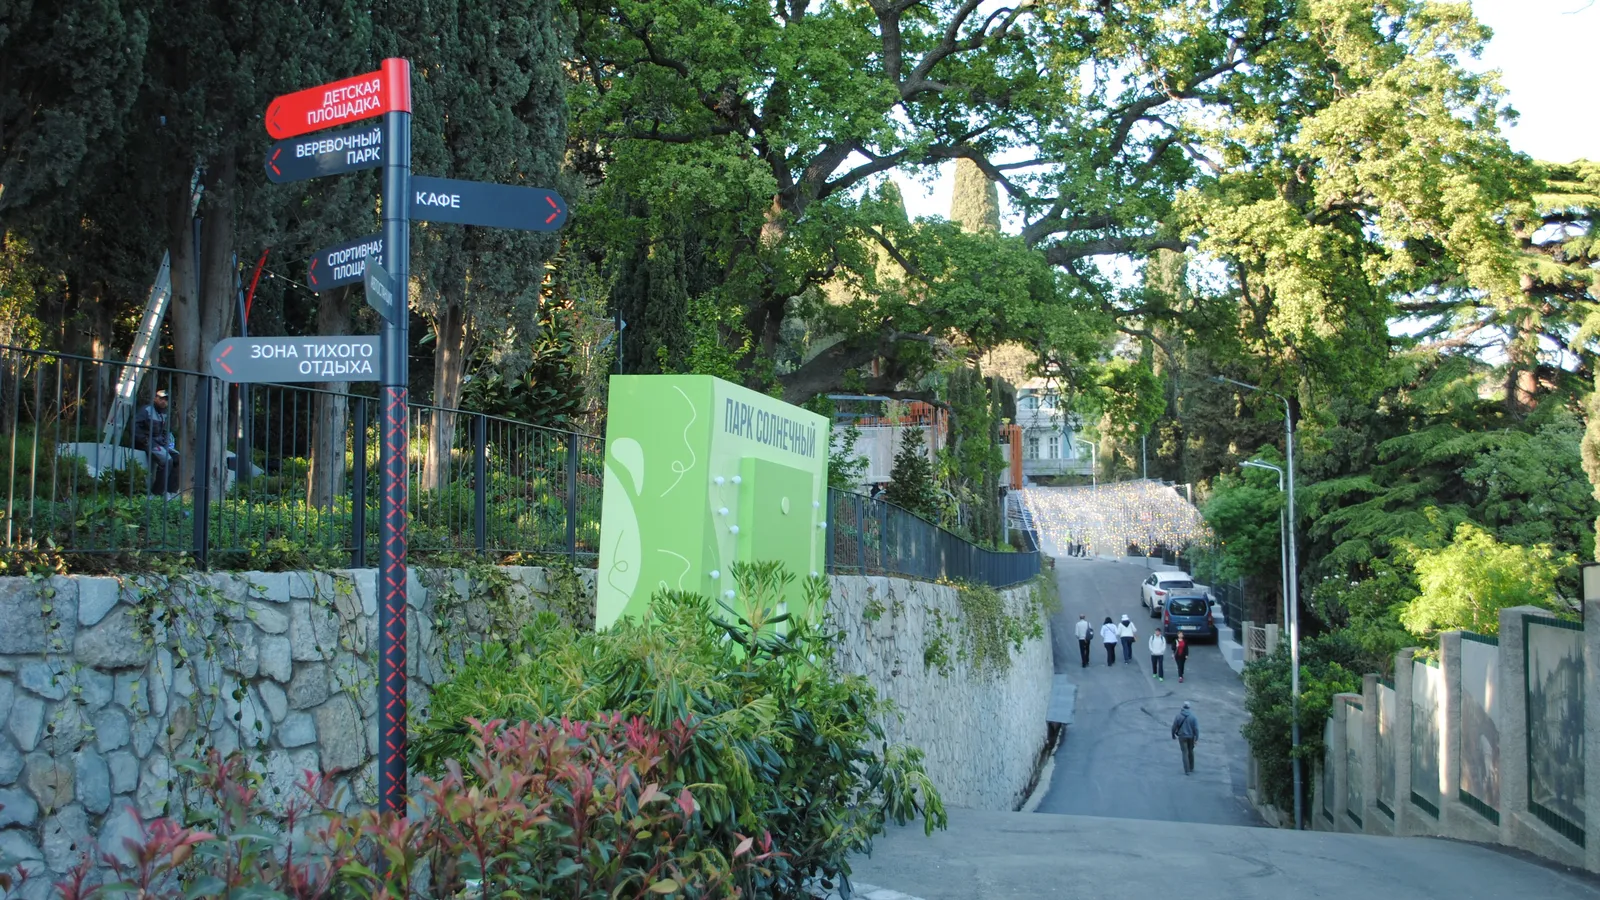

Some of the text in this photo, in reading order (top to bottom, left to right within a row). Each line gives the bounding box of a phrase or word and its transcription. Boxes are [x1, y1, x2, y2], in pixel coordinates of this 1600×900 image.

[322, 79, 380, 108] ДЕТСКАЯ
[307, 95, 381, 125] ПЛОЩАДКА
[296, 128, 381, 158] ВЕРЕВОЧНЫЙ
[346, 146, 381, 165] ПАРК
[415, 191, 461, 208] КАФЕ
[250, 344, 373, 359] ЗОНА ТИХОГО
[299, 360, 373, 377] ОТДЫХА
[724, 398, 816, 459] ПАРК СОЛНЕЧНЫЙ
